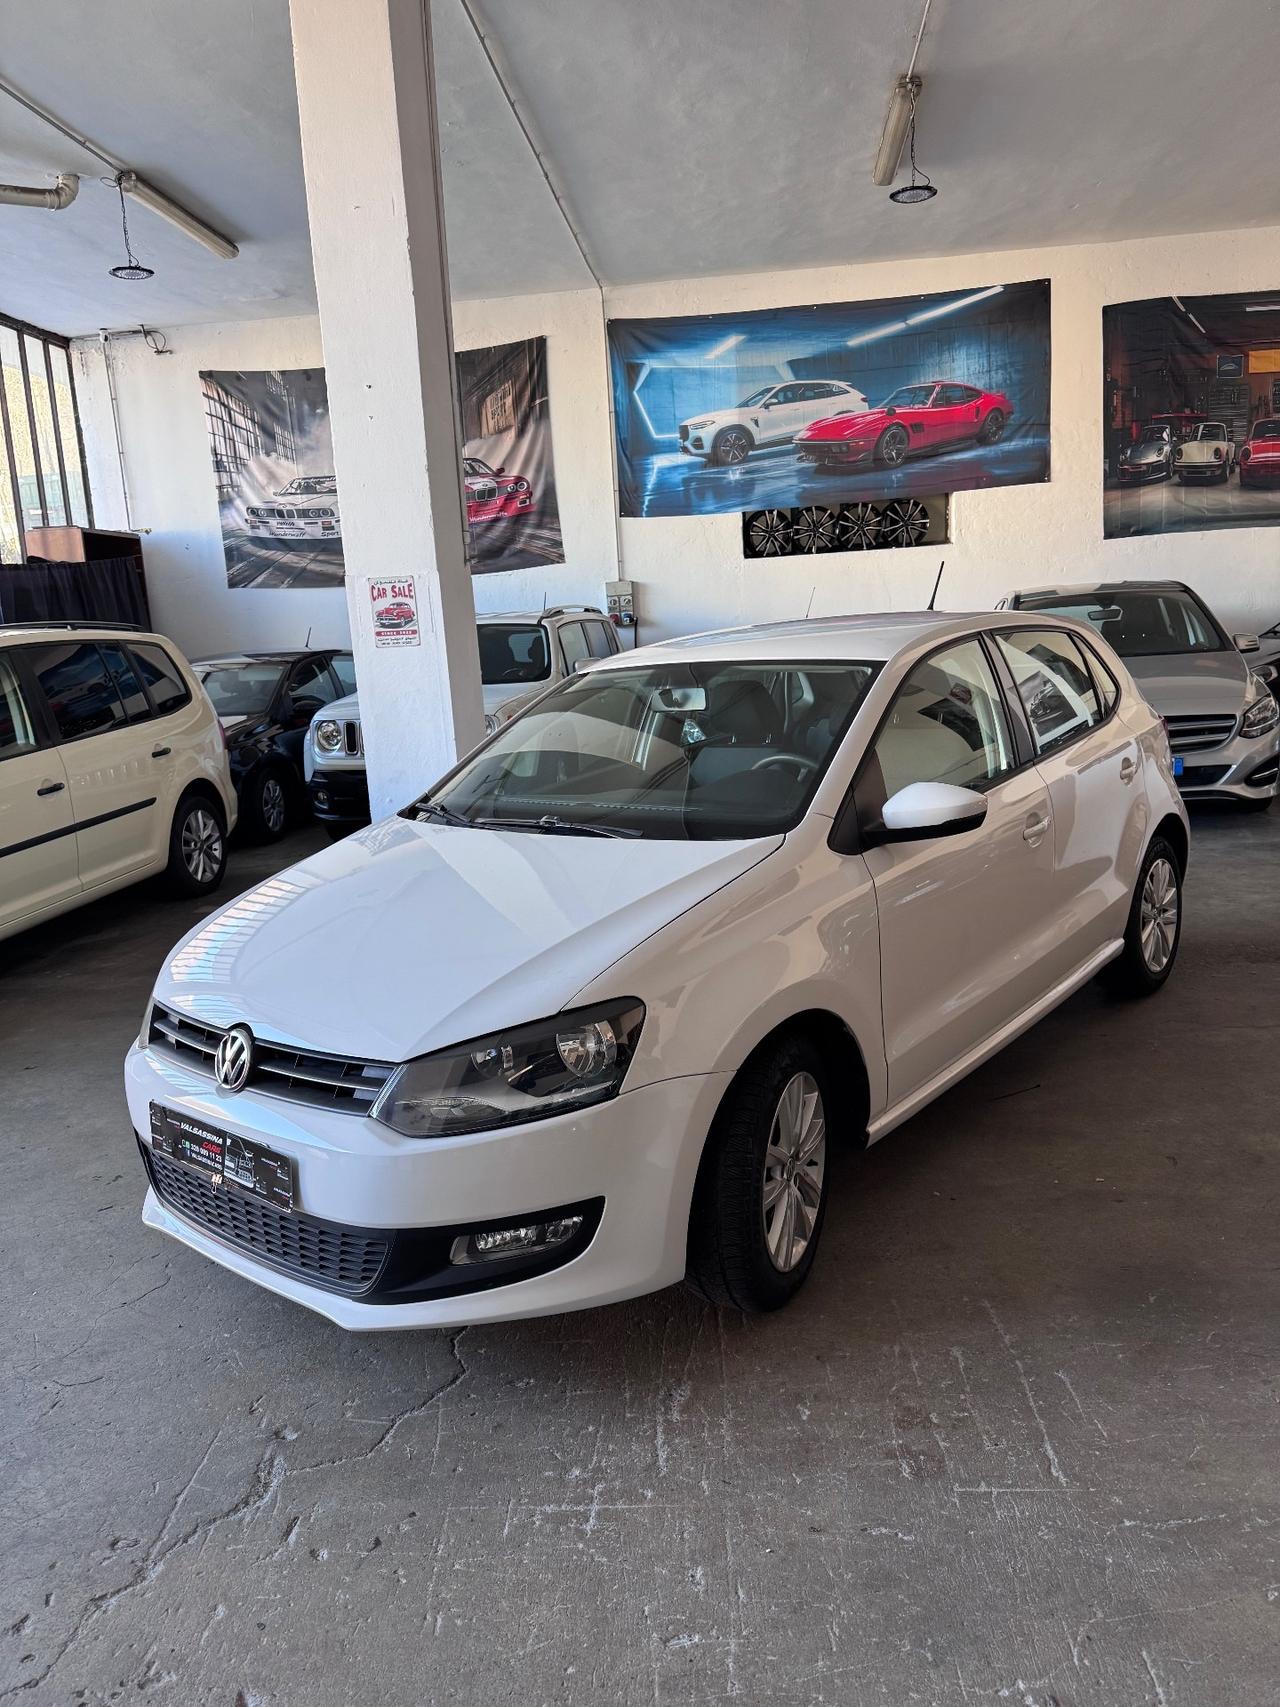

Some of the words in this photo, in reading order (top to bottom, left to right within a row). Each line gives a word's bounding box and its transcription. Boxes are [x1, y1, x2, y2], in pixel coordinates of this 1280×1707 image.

[371, 584, 387, 602] CAR
[391, 583, 414, 599] SALE
[180, 1122, 223, 1145] VALSASSINA
[202, 1141, 222, 1154] CARS
